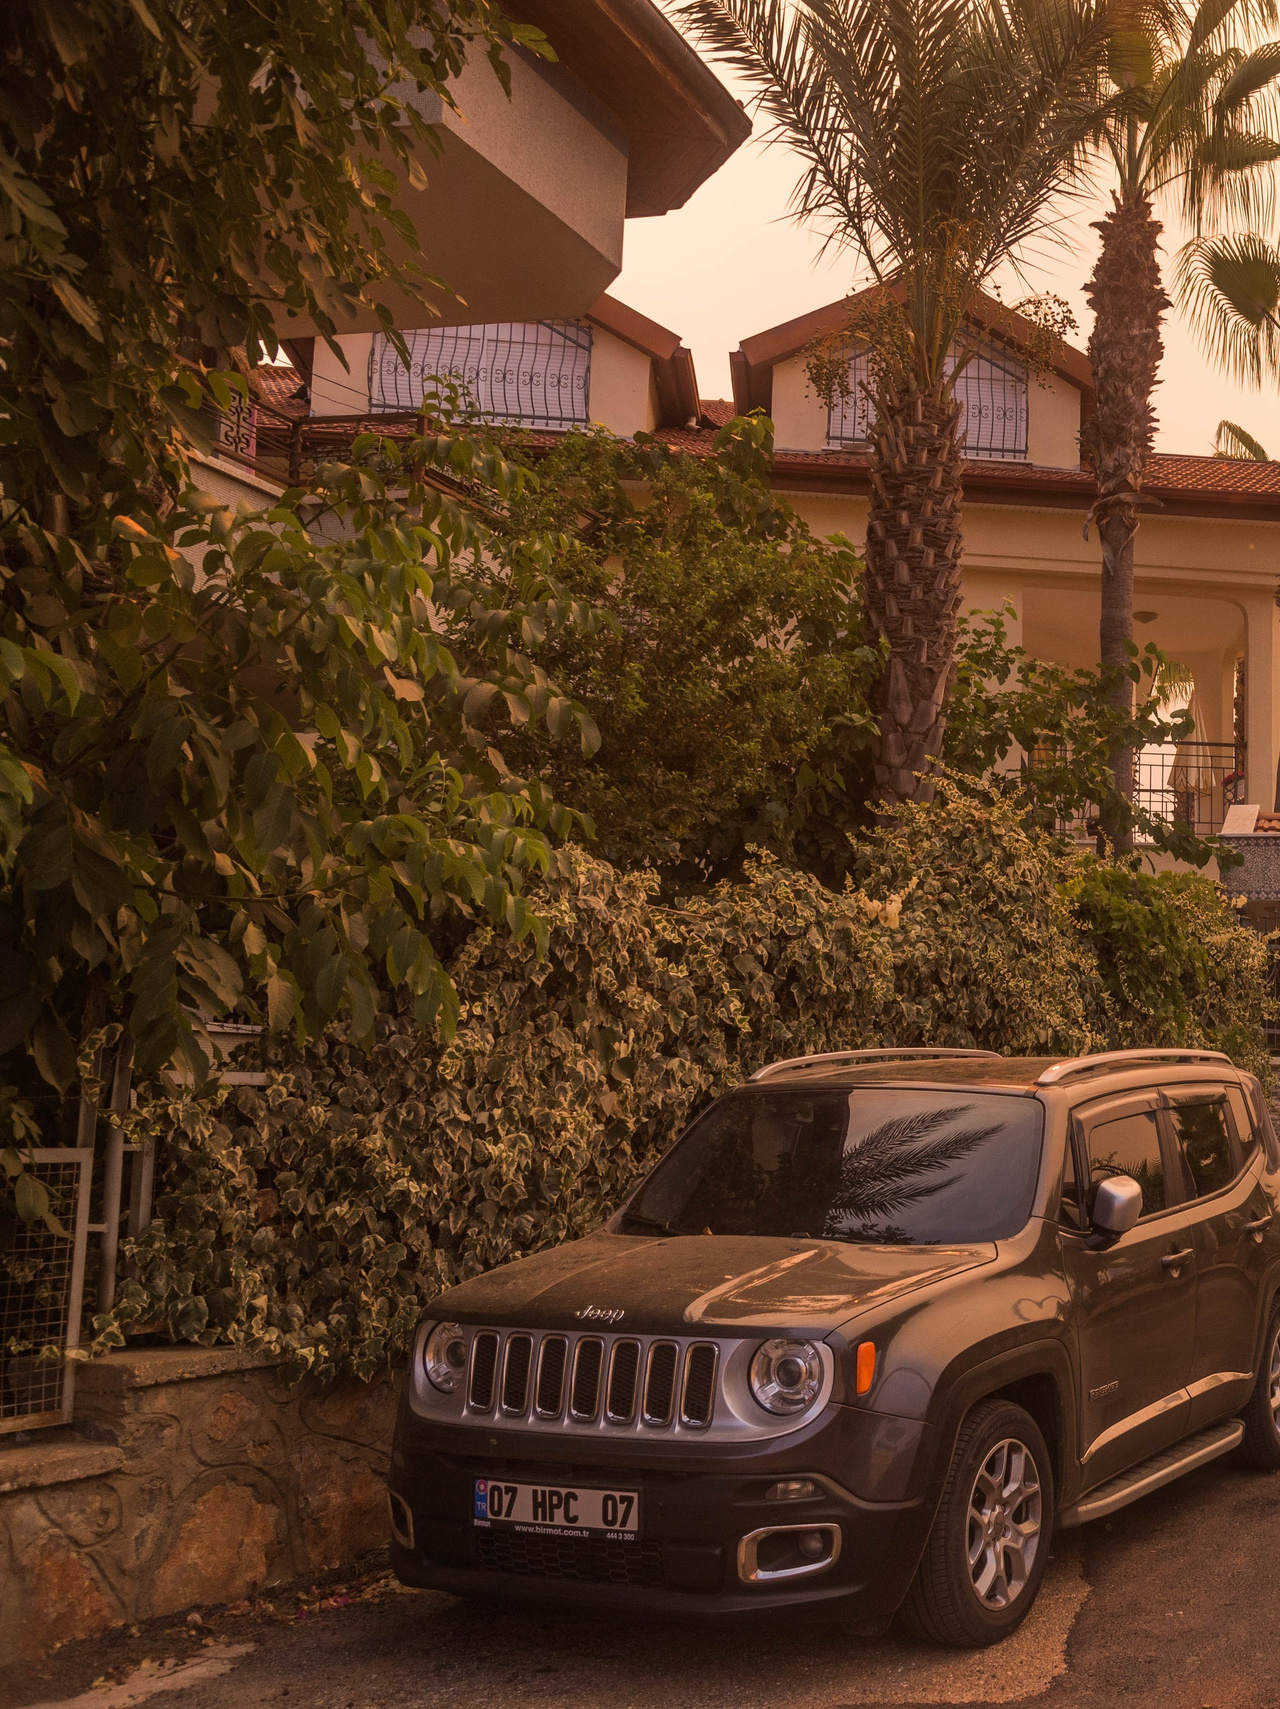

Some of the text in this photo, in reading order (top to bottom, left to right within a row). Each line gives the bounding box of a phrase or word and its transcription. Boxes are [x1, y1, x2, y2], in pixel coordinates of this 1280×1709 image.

[575, 1305, 625, 1324] Jeep
[477, 1502, 486, 1511] TR
[490, 1485, 634, 1528] 07 HPC 07
[474, 1519, 491, 1527] Birmot
[515, 1525, 589, 1537] www.birmot.com.tr
